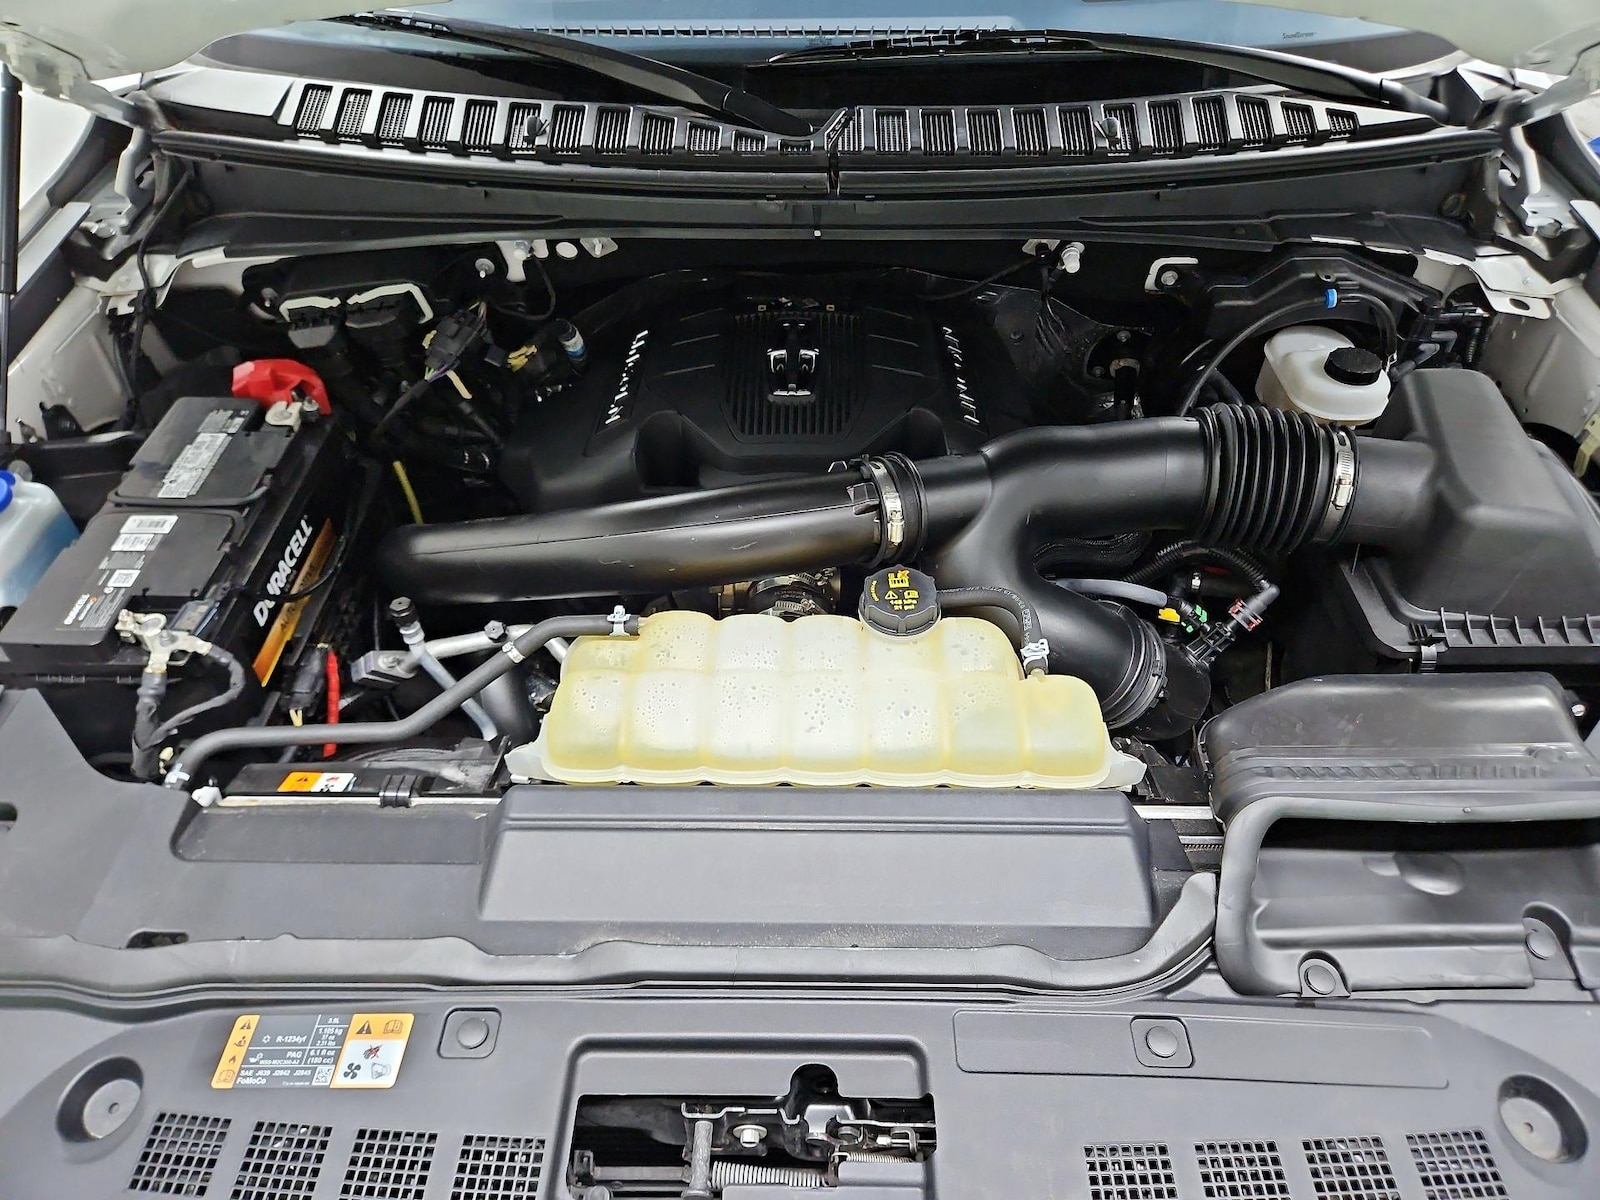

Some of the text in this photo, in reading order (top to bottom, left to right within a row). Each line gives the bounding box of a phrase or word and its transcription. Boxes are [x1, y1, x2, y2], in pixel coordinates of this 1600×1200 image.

[335, 1027, 344, 1036] kg
[276, 1035, 308, 1044] R-1234yf
[307, 1056, 334, 1065] (180 cc)
[236, 1076, 267, 1085] FoMoCo
